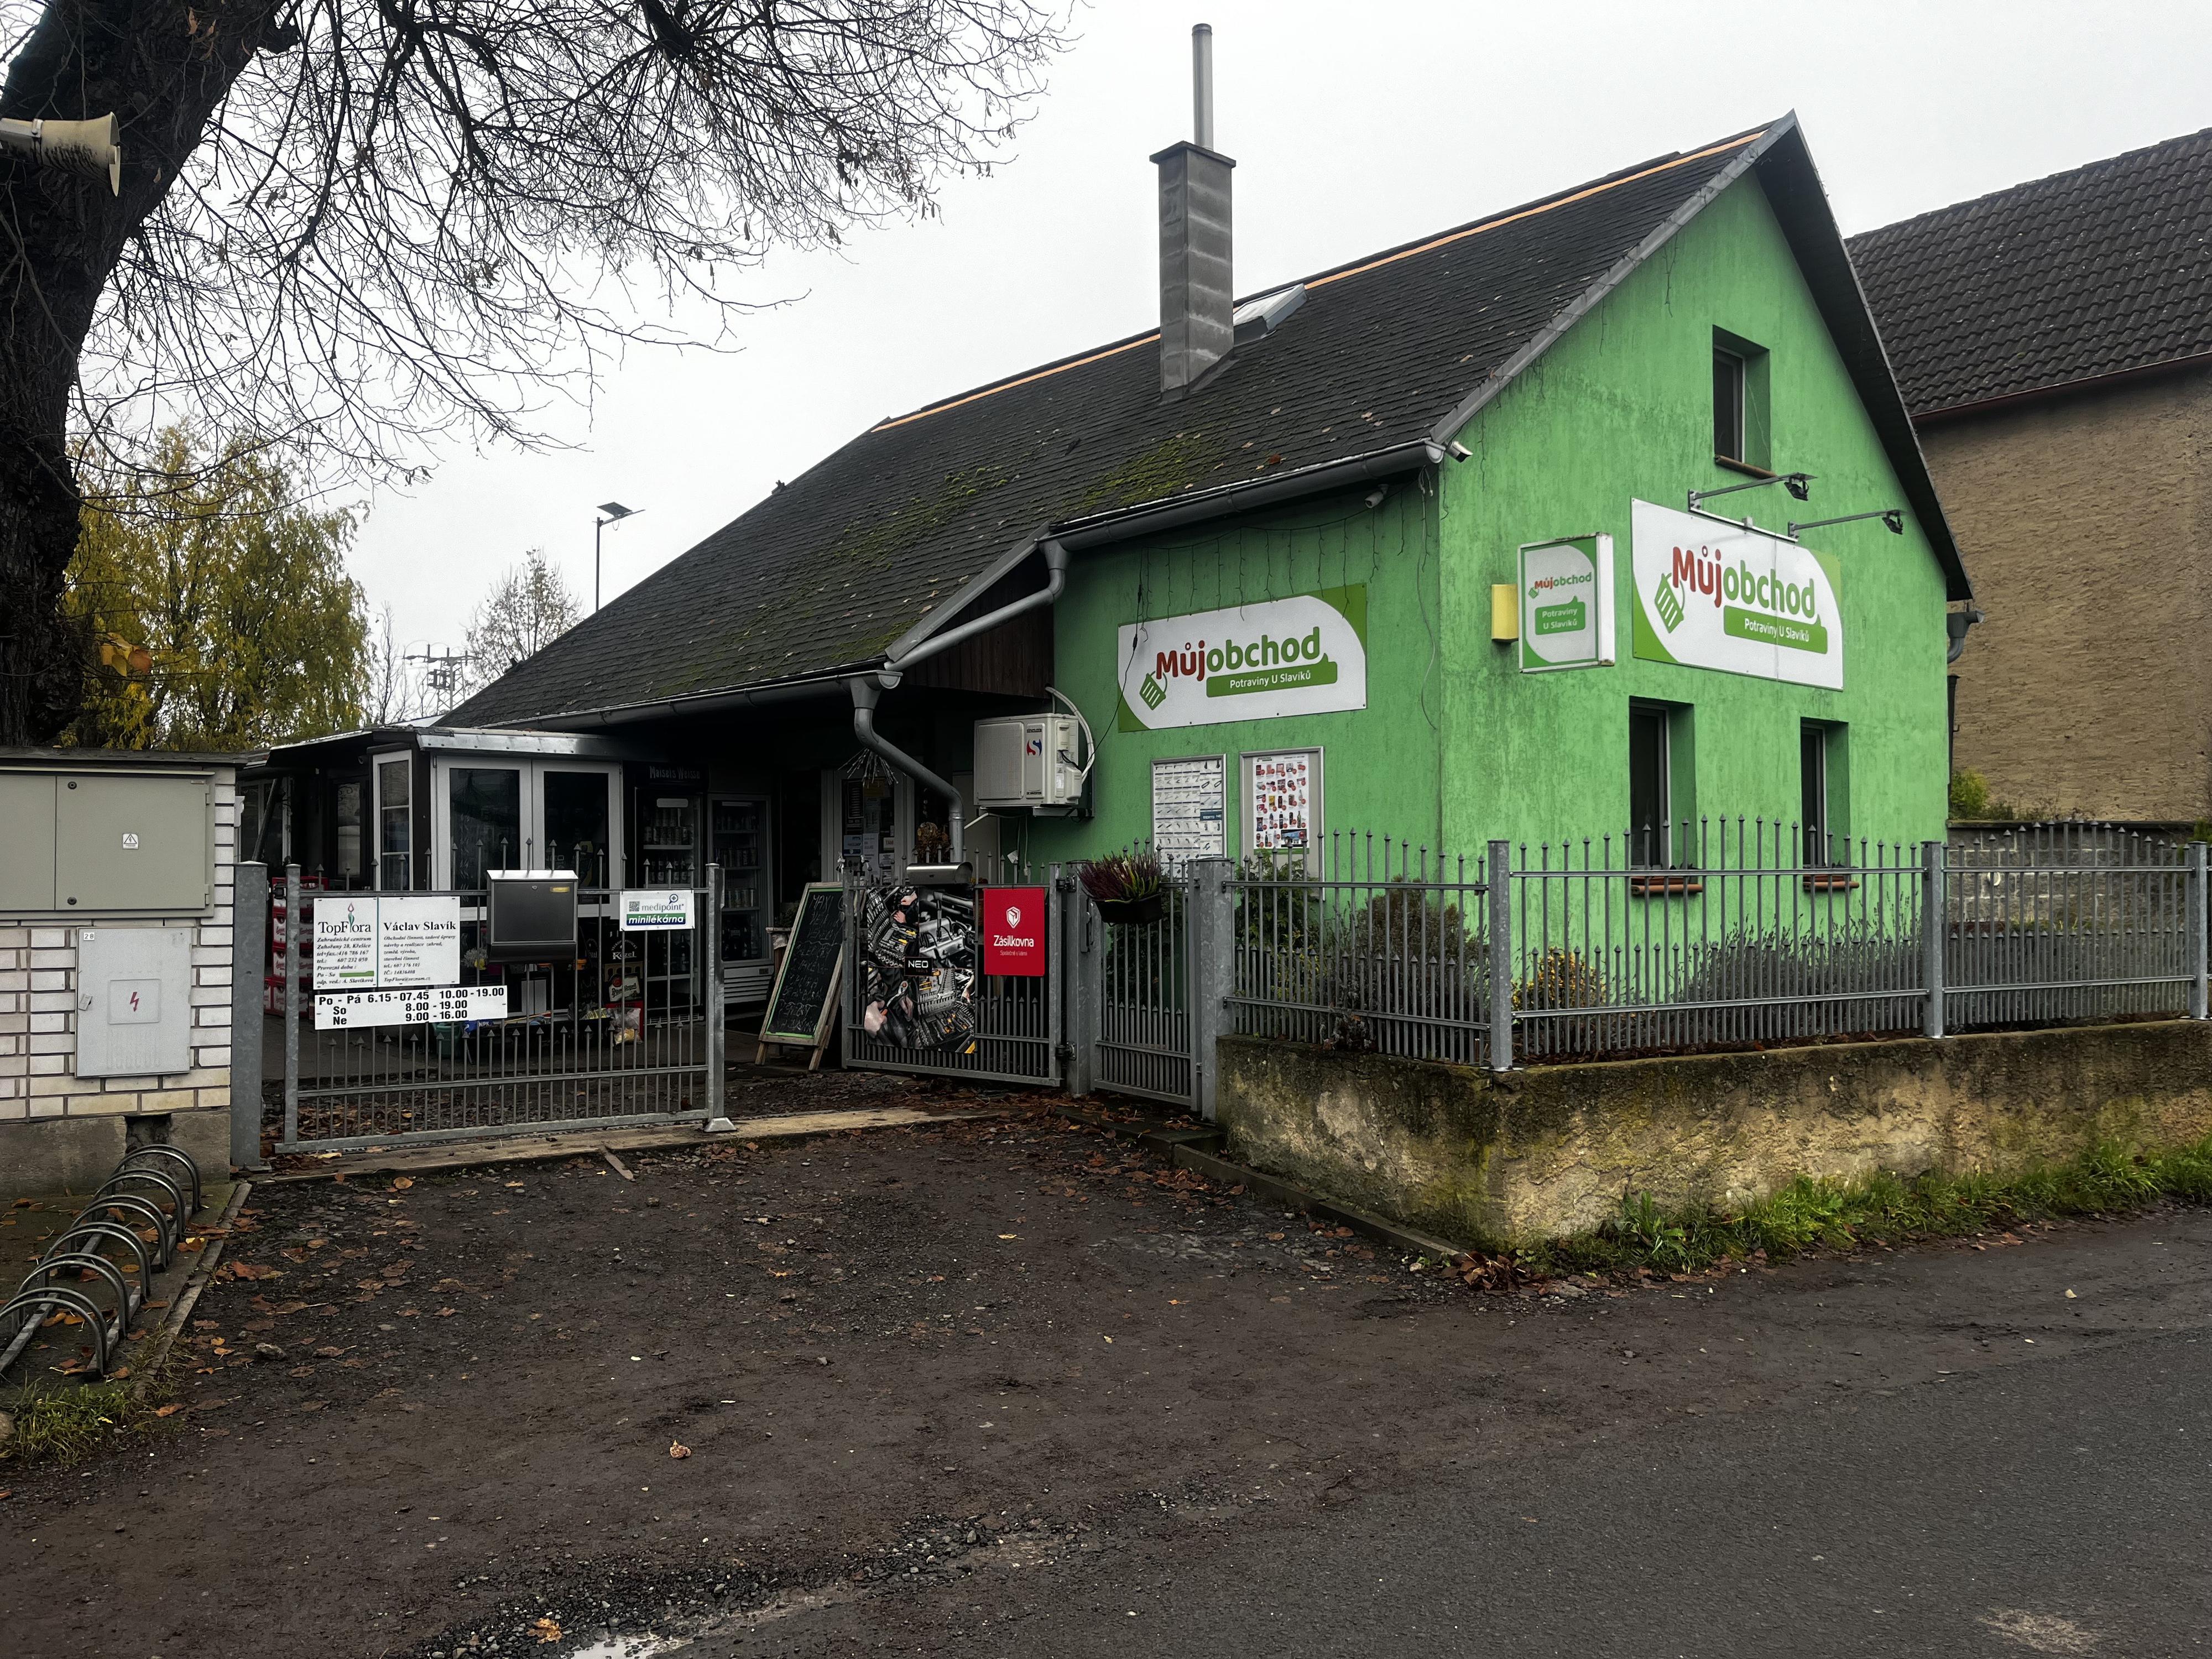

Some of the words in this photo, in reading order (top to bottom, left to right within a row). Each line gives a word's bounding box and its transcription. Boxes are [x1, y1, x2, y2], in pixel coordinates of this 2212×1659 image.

[1542, 608, 1578, 618] Potraviny
[1744, 618, 1778, 638] Potraviny
[1779, 626, 1785, 637] U
[1786, 627, 1809, 641] Slavíků
[1230, 676, 1269, 688] Potraviny
[1272, 675, 1277, 684] U
[1280, 670, 1311, 682] Slavíků
[641, 903, 682, 912] medipoint
[629, 915, 684, 924] minilékárna
[318, 921, 371, 936] TopFlora
[384, 922, 420, 931] Václav
[424, 921, 456, 930] Slavík
[993, 935, 1034, 947] Zásilkovna
[319, 997, 333, 1005] Po
[347, 994, 361, 1004] Pá
[333, 1006, 347, 1015] So
[405, 1002, 429, 1011] 8.00
[440, 1000, 467, 1010] 19.00
[333, 1016, 347, 1025] Ne
[405, 1012, 429, 1021] 9.00
[440, 1010, 467, 1019] 16.00
